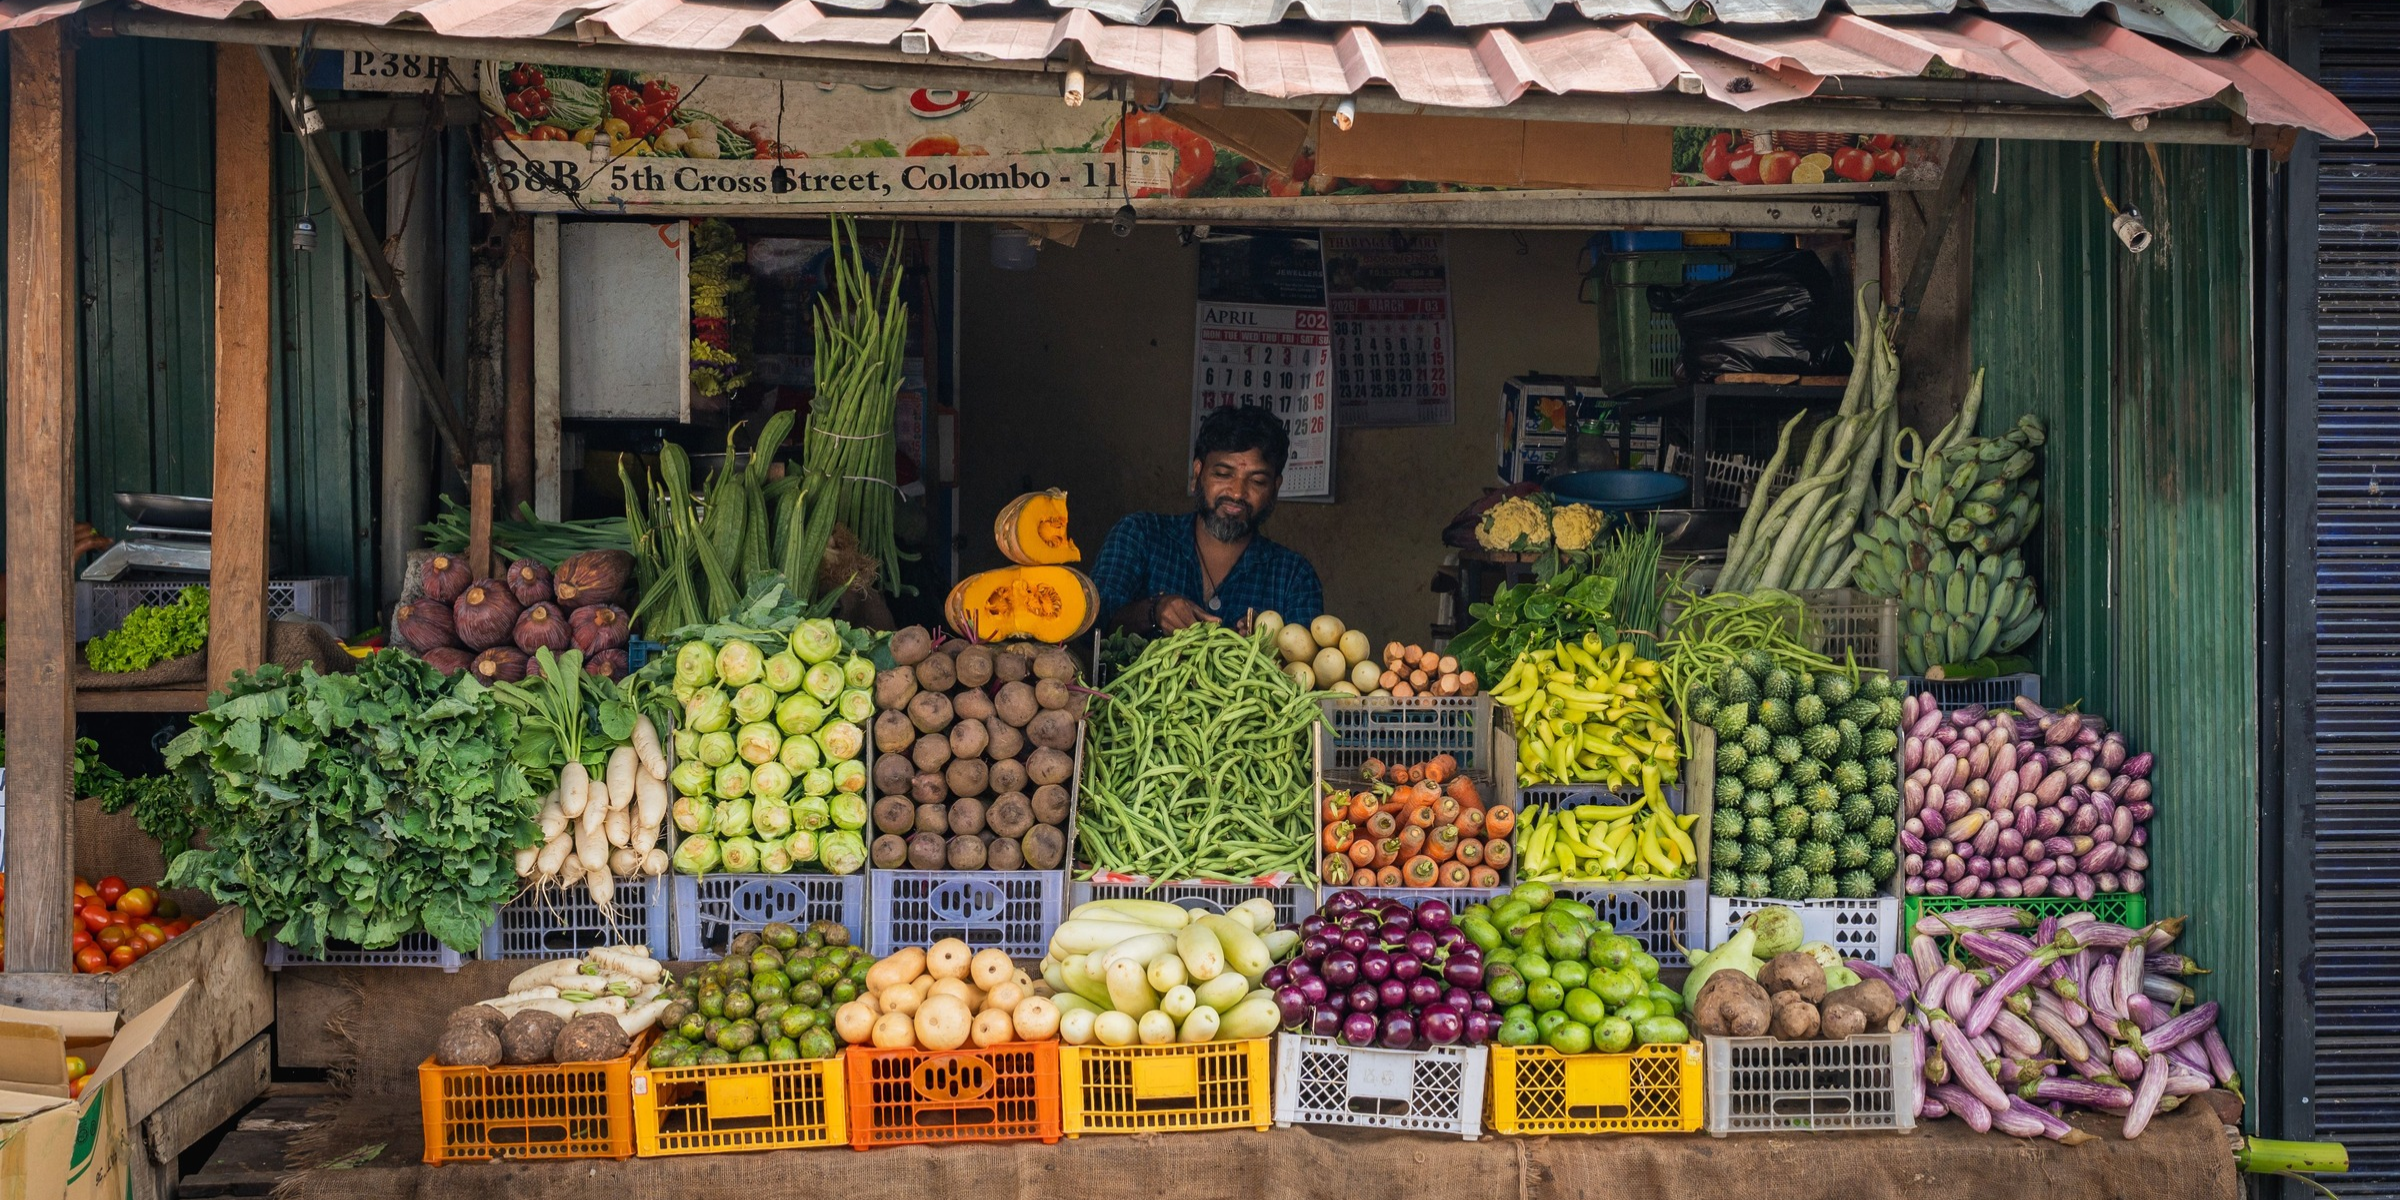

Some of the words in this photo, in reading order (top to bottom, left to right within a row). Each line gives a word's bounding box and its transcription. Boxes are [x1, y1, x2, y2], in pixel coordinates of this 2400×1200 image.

[498, 159, 581, 193] 38B
[611, 164, 665, 192] 5th
[674, 165, 767, 192] Cross
[783, 168, 891, 196] Street,
[902, 164, 1050, 191] Colombo
[1083, 162, 1119, 188] 11
[1276, 268, 1324, 278] JEWELLERS
[1332, 300, 1356, 313] 2026
[1368, 299, 1405, 312] MARCH
[1424, 300, 1439, 312] 03
[1203, 307, 1258, 325] APRIL
[1297, 313, 1328, 330] 202
[1334, 322, 1348, 336] 30
[1352, 322, 1362, 335] 31
[1434, 322, 1440, 334] 1
[1203, 329, 1220, 340] MON
[1223, 330, 1239, 342] TUE
[1241, 332, 1258, 343] WED
[1262, 332, 1278, 343] THU
[1282, 333, 1295, 344] FRI
[1300, 335, 1314, 345] SAT
[1318, 336, 1330, 345] SU
[1338, 338, 1346, 350] 2
[1354, 338, 1361, 351] 3
[1370, 338, 1377, 350] 4
[1385, 338, 1392, 350] 5
[1400, 338, 1408, 350] 6
[1416, 338, 1424, 350] 7
[1434, 337, 1441, 350] 8
[1264, 347, 1272, 364] 2
[1283, 348, 1291, 366] 3
[1302, 349, 1310, 366] 4
[1320, 350, 1327, 365] 5
[1340, 354, 1346, 366] 9
[1352, 354, 1364, 366] 10
[1369, 353, 1380, 366] 11
[1384, 353, 1395, 366] 12
[1399, 353, 1410, 366] 13
[1415, 353, 1427, 366] 14
[1431, 352, 1444, 366] 15
[1206, 368, 1214, 385] 6
[1226, 369, 1232, 386] 7
[1244, 370, 1252, 387] 8
[1263, 371, 1270, 388] 9
[1279, 372, 1292, 389] 10
[1299, 372, 1310, 390] 11
[1314, 370, 1324, 387] 12
[1338, 370, 1350, 382] 16
[1354, 370, 1364, 382] 17
[1370, 370, 1382, 382] 18
[1385, 370, 1396, 382] 19
[1400, 369, 1412, 382] 20
[1416, 369, 1428, 382] 21
[1431, 368, 1446, 381] 22
[1339, 385, 1352, 398] 23
[1354, 385, 1367, 398] 24
[1370, 385, 1383, 398] 25
[1385, 385, 1398, 398] 26
[1400, 385, 1412, 398] 27
[1416, 384, 1429, 397] 28
[1432, 383, 1446, 397] 29
[1202, 392, 1215, 408] 13
[1259, 395, 1272, 410] 16
[1280, 396, 1291, 413] 17
[1298, 396, 1308, 412] 18
[1312, 393, 1324, 410] 19
[1294, 419, 1308, 436] 25
[1310, 416, 1324, 434] 26
